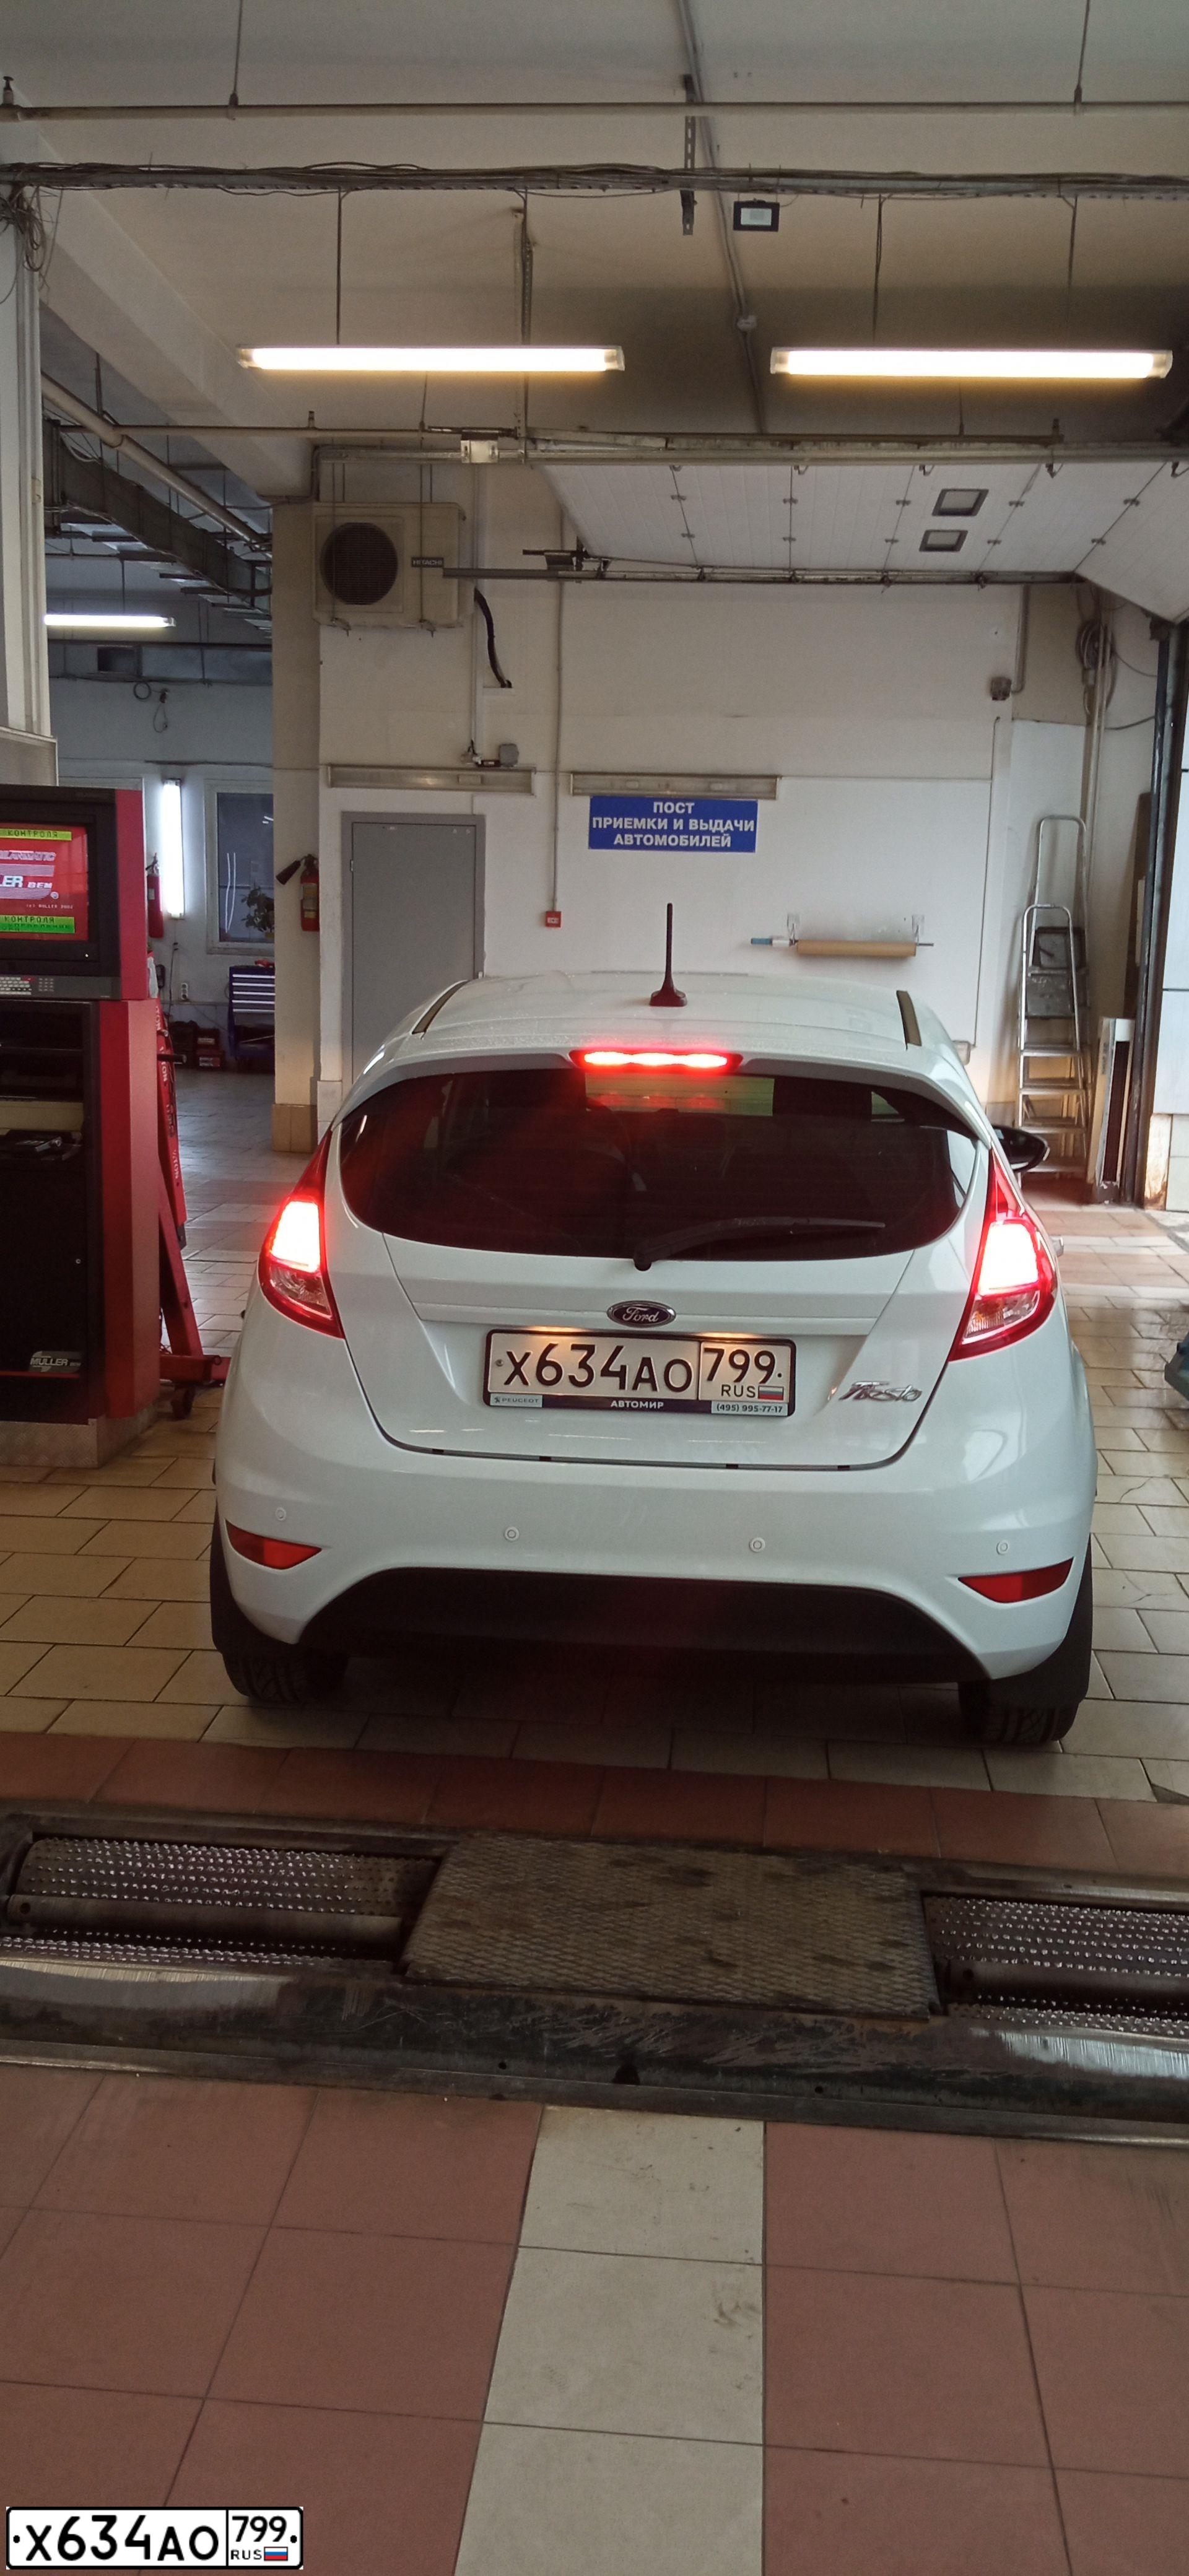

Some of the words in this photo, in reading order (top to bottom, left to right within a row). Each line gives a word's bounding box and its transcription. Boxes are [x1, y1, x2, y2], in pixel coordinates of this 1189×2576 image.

[653, 802, 695, 814] ПОСТ
[592, 817, 668, 830] ПРИЕМКИ
[673, 819, 683, 830] И
[689, 819, 754, 833] ВЫДАЧИ
[7, 830, 58, 838] КОНТРОЛЯ
[613, 833, 731, 847] АВТОМОБИЛЕЙ
[622, 1306, 660, 1322] Ford
[30, 1357, 69, 1366] MULLER
[704, 1347, 775, 1385] 799
[721, 1385, 756, 1398] RUS
[838, 1380, 923, 1402] Fiesta
[611, 1399, 664, 1409] АВТОМИР
[716, 1403, 739, 1412] (495)
[742, 1404, 783, 1412] 995-77-17
